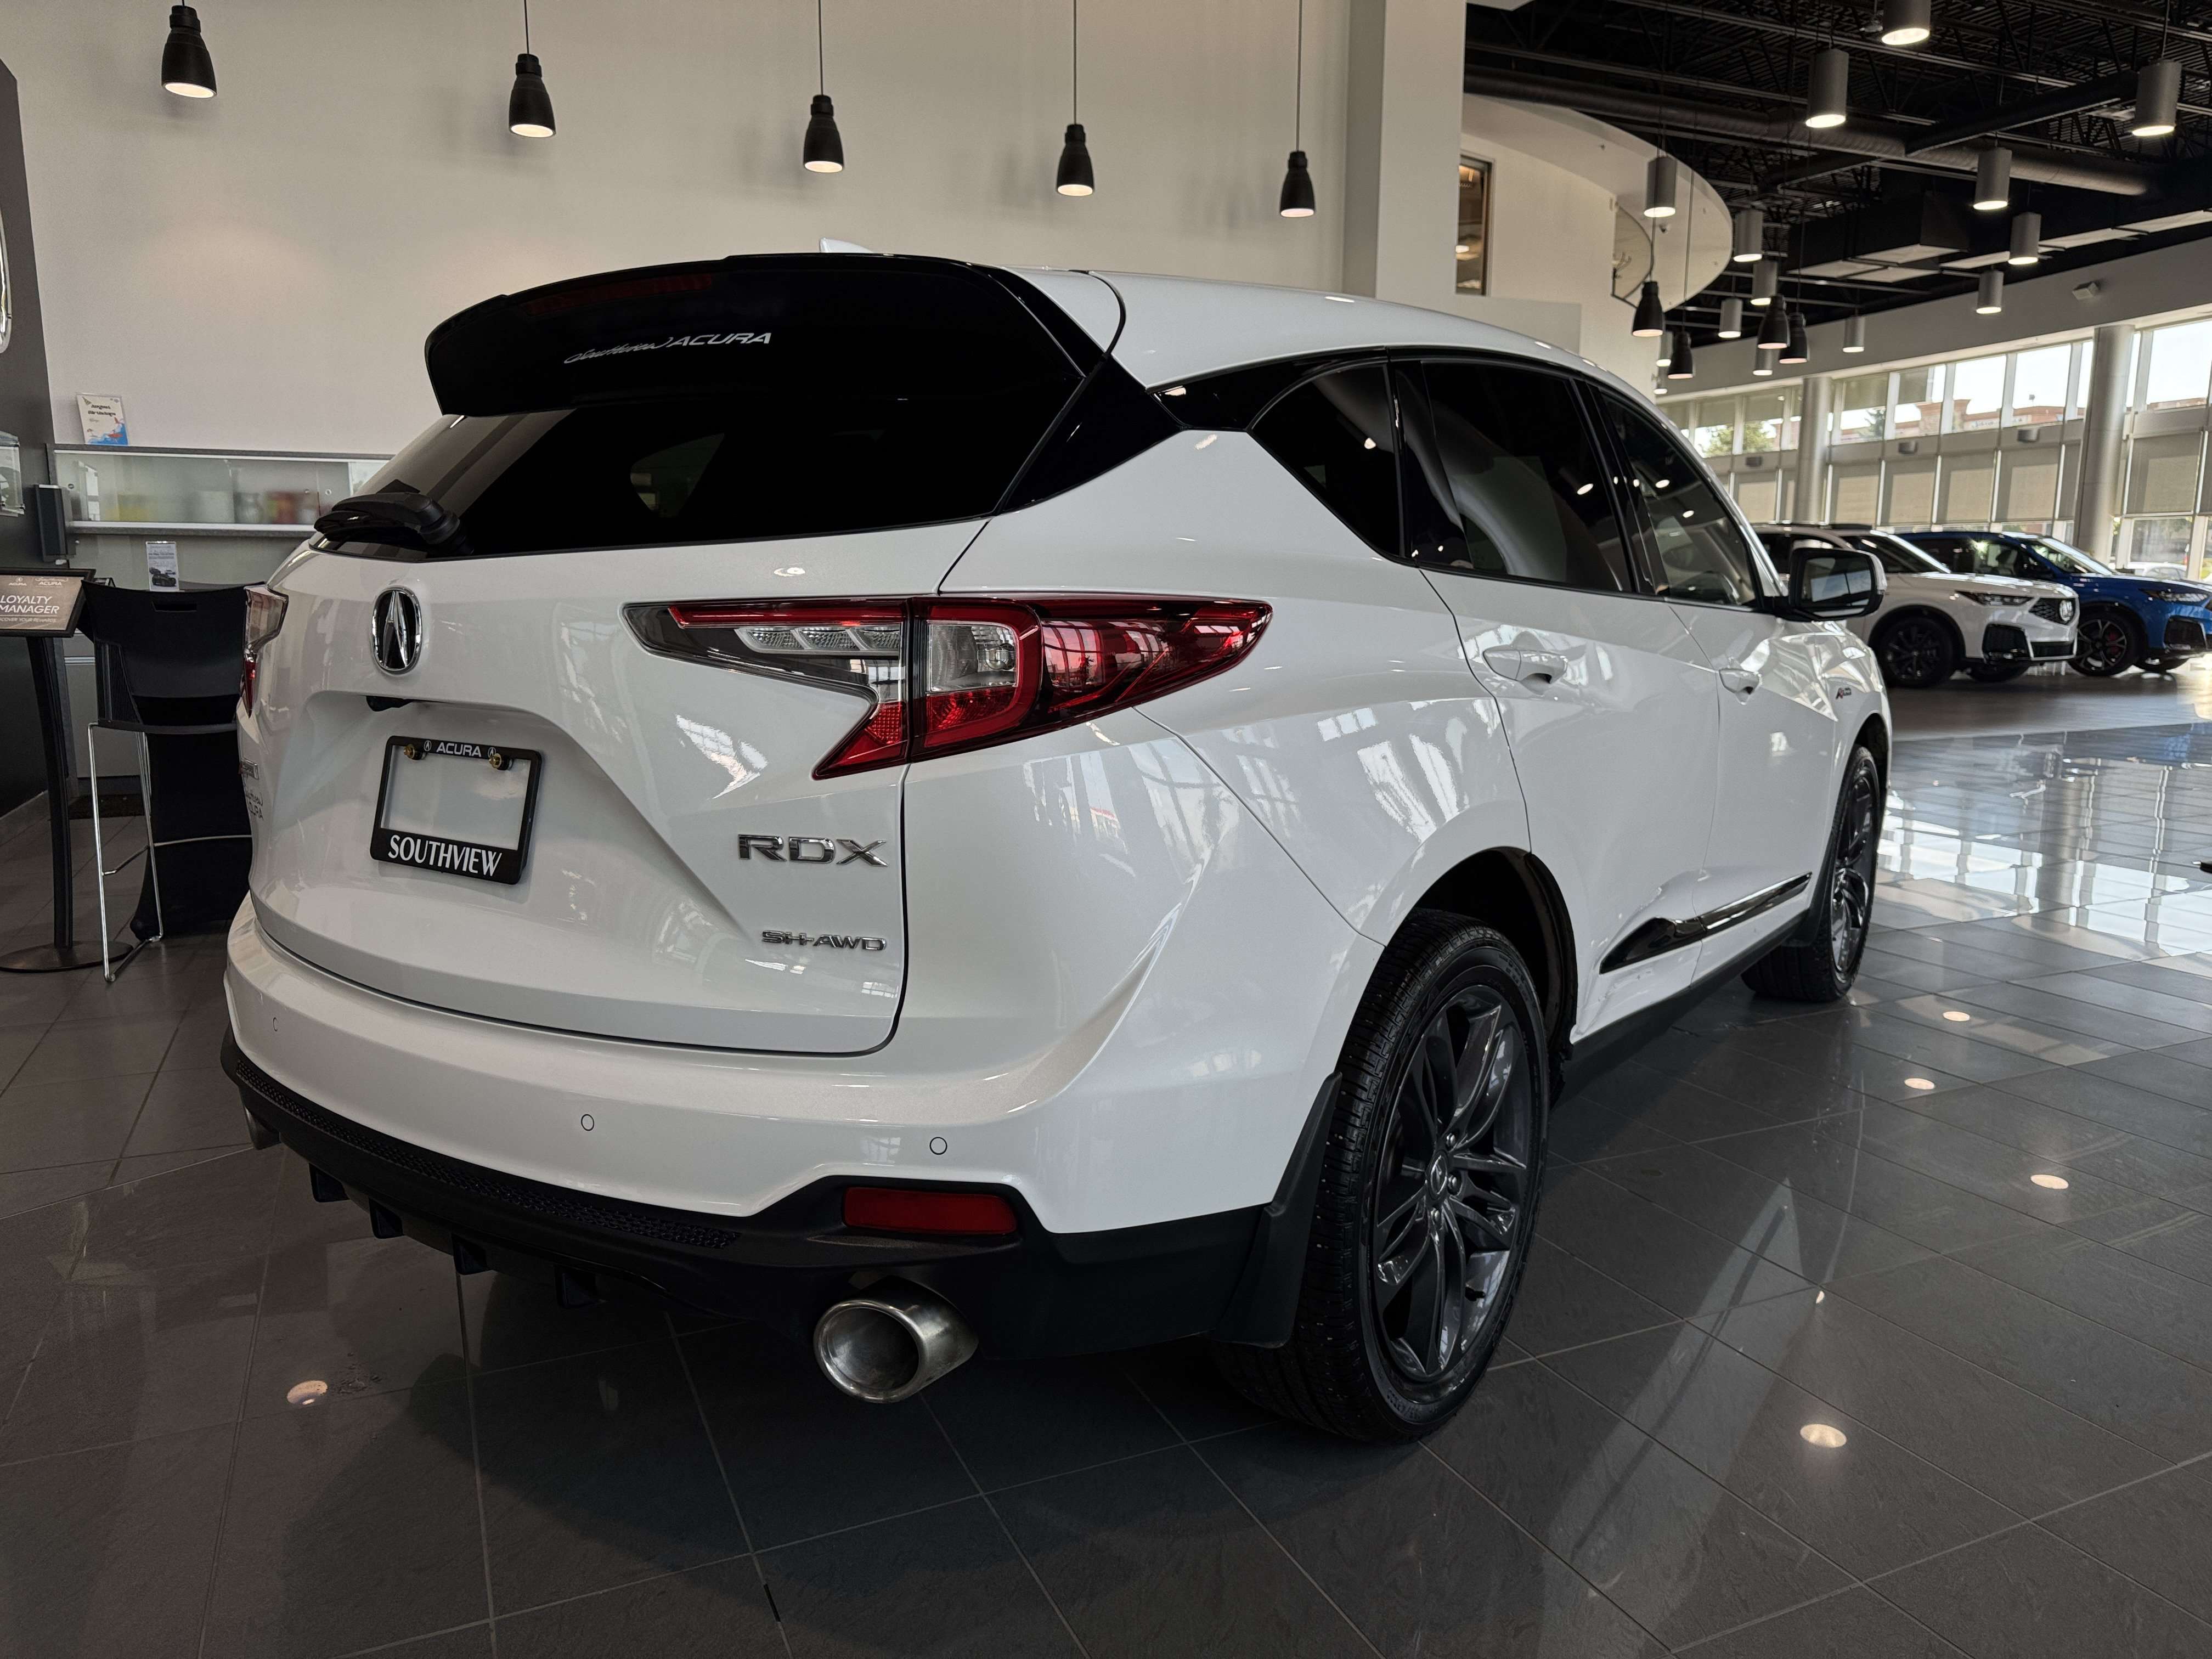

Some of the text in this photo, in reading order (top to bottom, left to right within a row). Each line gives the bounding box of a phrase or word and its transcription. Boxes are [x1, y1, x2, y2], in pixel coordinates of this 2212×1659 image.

[666, 332, 772, 347] ACURA
[0, 595, 52, 604] LOYALTY
[0, 605, 60, 614] MANAGER
[436, 742, 482, 758] ACURA
[388, 834, 503, 877] SOUTHVIEW
[738, 833, 889, 867] RDX
[761, 929, 888, 951] SH-AWD
